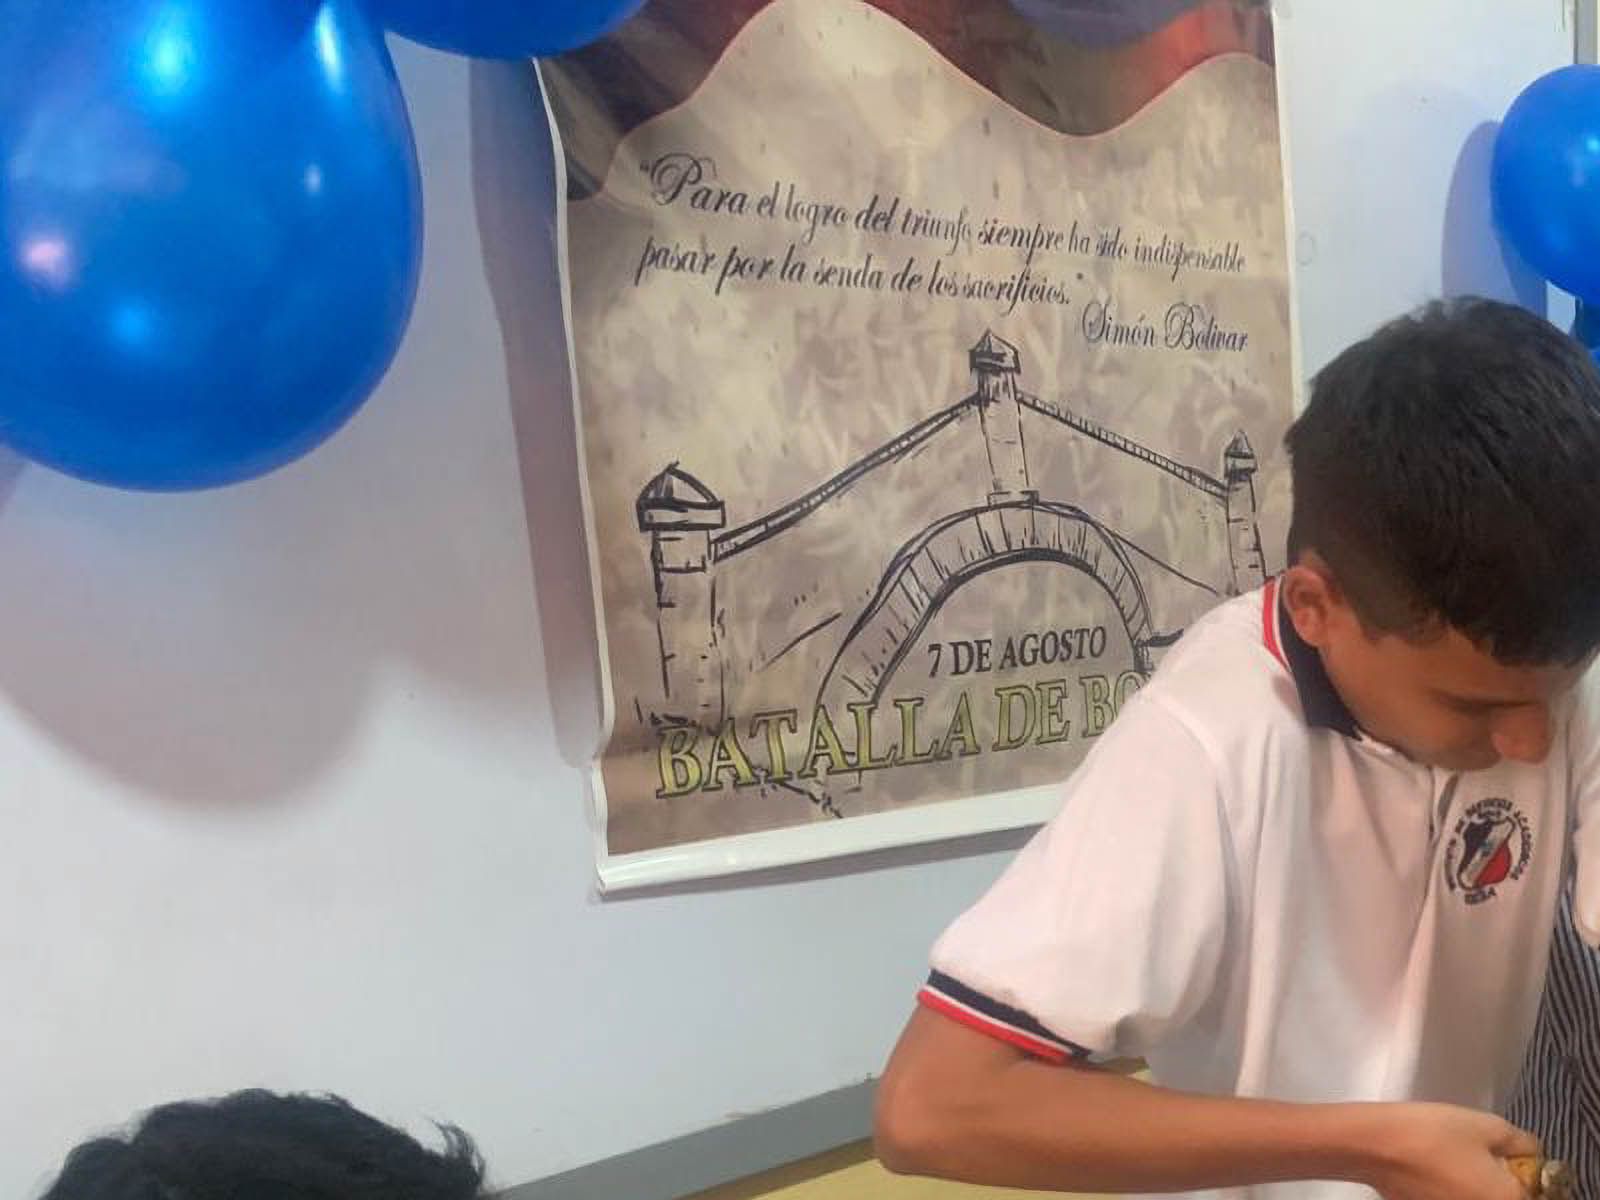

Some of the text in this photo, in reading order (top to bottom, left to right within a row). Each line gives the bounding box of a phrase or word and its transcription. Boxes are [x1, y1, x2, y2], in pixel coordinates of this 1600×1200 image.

[757, 180, 780, 218] el
[784, 183, 848, 246] logro
[855, 194, 900, 232] del
[902, 207, 972, 256] triunfo
[978, 218, 1064, 266] siempre
[1067, 220, 1091, 254] ha
[1096, 226, 1128, 259] sido
[1134, 232, 1247, 283] indispensable
[636, 236, 715, 287] pasar
[714, 246, 774, 296] por
[780, 244, 805, 282] la
[813, 253, 884, 290] senda
[890, 257, 923, 293] de
[927, 258, 958, 297] los
[1081, 298, 1156, 345] Simón
[927, 626, 1107, 677] 7 DE AGOSTO
[655, 690, 982, 798] BATALLA
[991, 680, 1072, 752] DE
